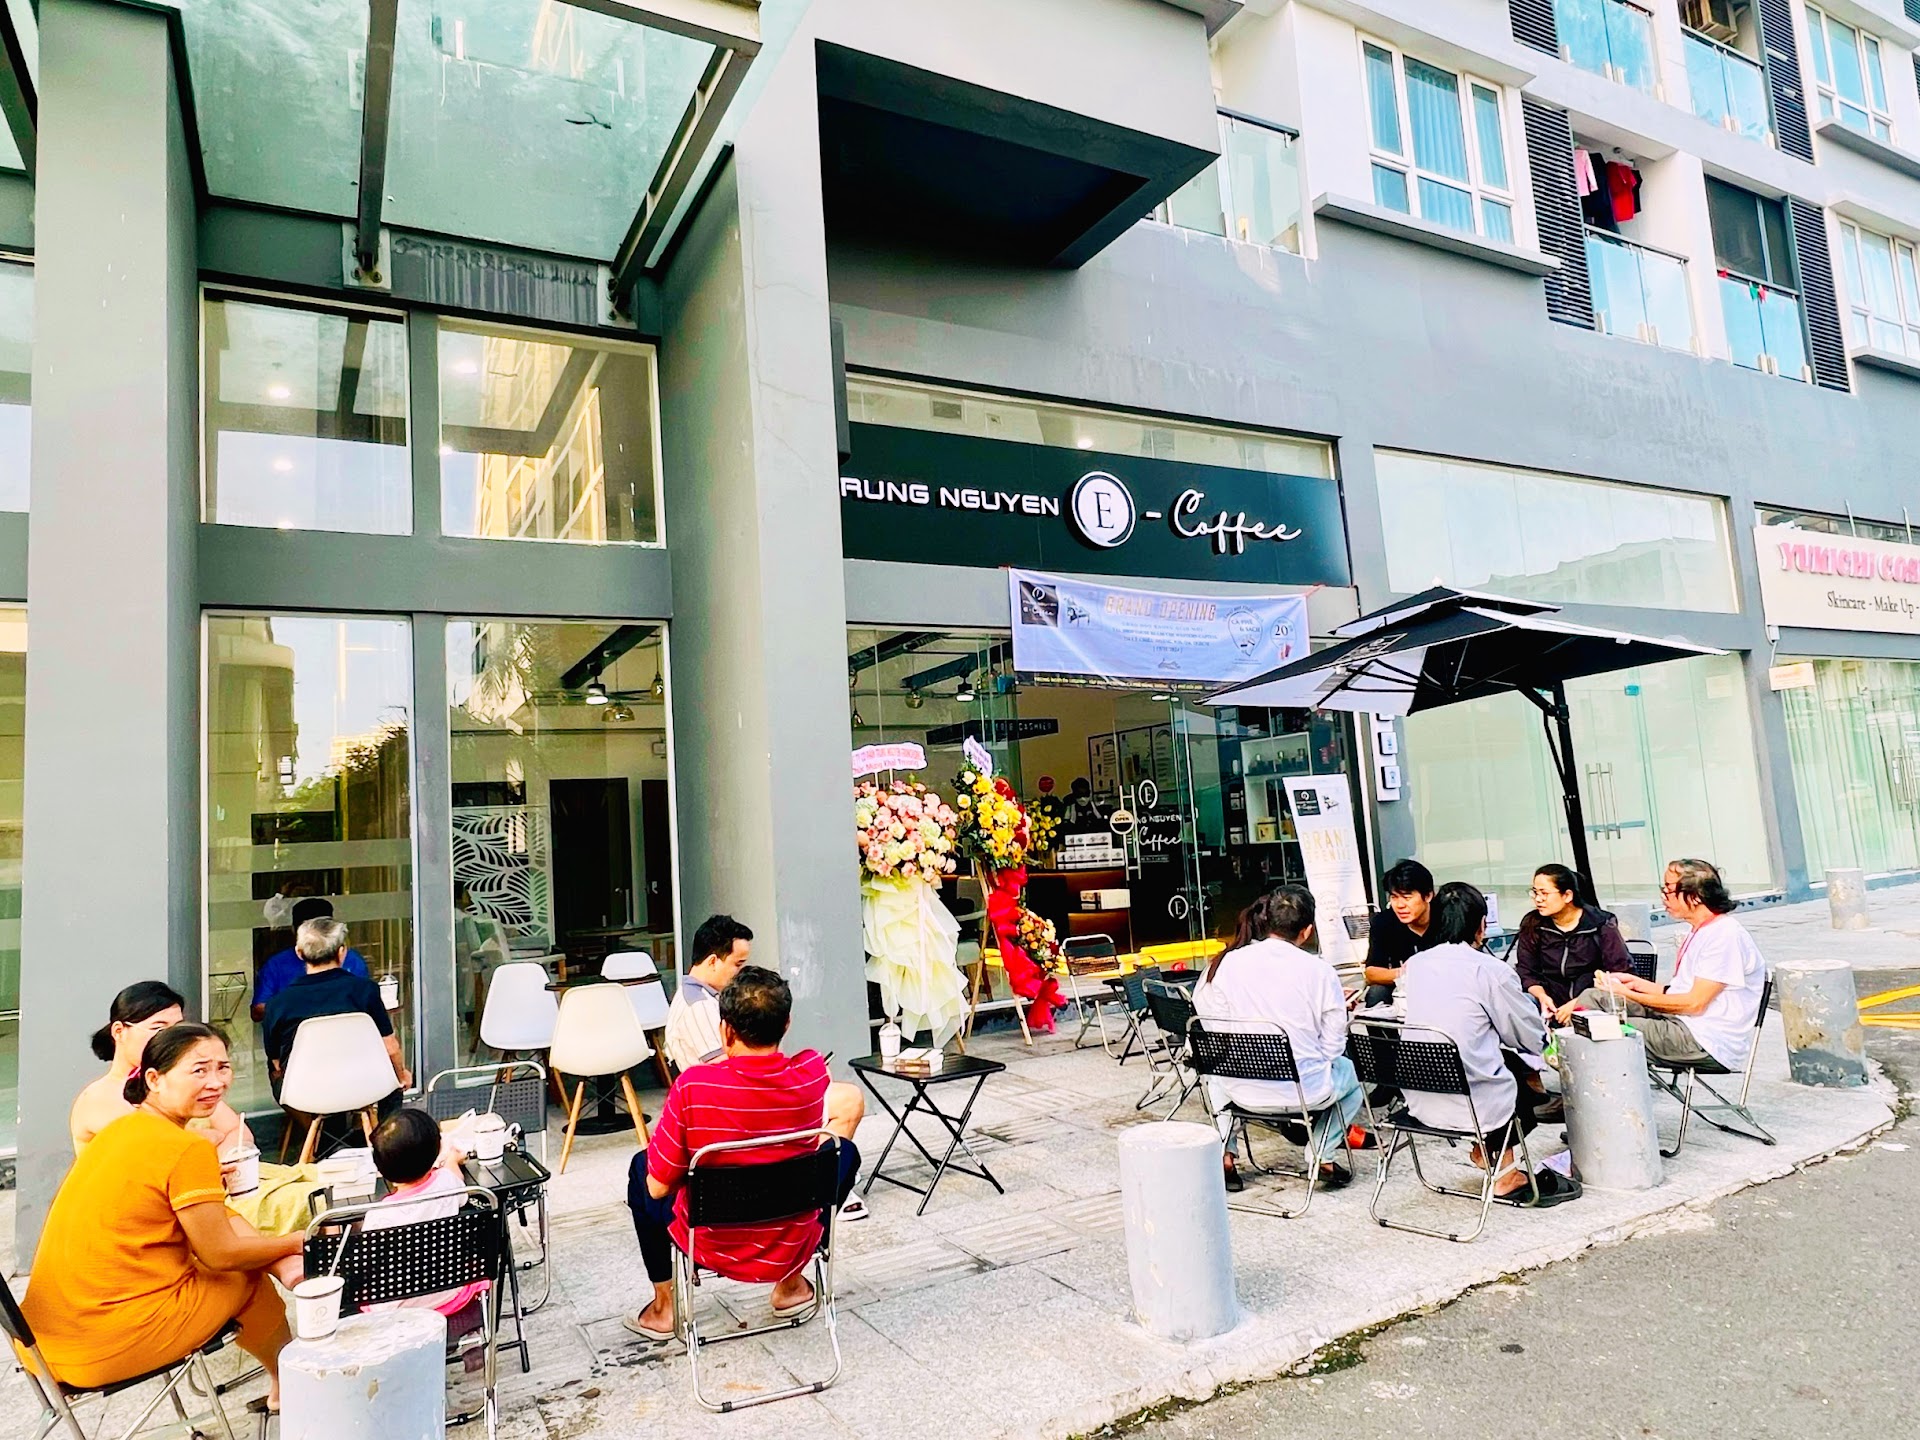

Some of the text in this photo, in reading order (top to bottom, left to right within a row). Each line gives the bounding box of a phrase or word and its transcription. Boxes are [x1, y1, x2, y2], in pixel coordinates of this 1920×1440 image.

[839, 476, 930, 504] RUNG
[939, 487, 1060, 516] NGUYEN
[1174, 488, 1302, 554] Coffee
[1105, 595, 1153, 617] GRAND
[1159, 601, 1217, 622] OPENING
[1827, 590, 1866, 610] Skincare
[1874, 595, 1899, 613] Make
[1900, 598, 1915, 619] Up
[1139, 826, 1182, 851] Coffee
